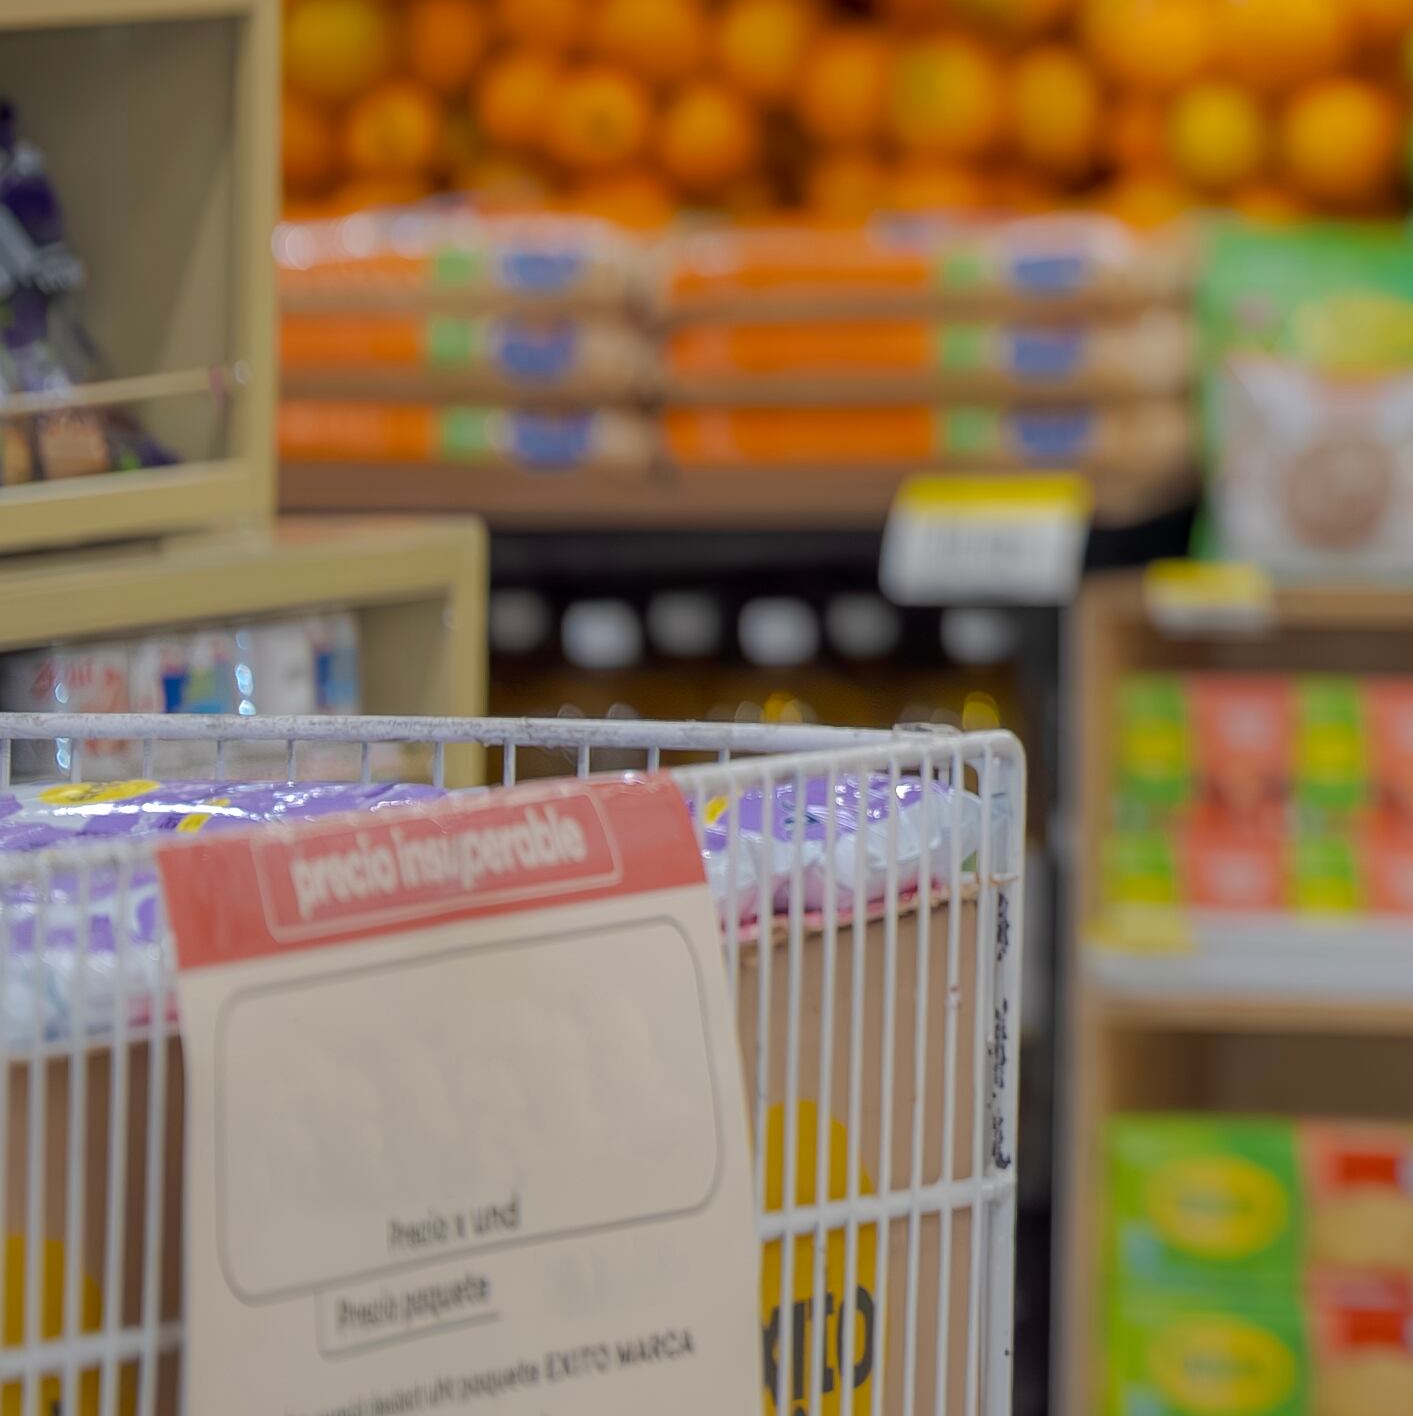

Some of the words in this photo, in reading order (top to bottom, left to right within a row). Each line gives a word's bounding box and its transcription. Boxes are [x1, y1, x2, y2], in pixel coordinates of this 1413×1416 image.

[291, 830, 397, 921] precio
[391, 804, 588, 890] insuperable
[387, 1206, 448, 1251] Precio
[473, 1191, 520, 1234] und
[336, 1289, 398, 1334] Precio
[404, 1271, 491, 1322] paquete
[461, 1360, 539, 1402] paquete
[615, 1328, 695, 1367] MARCA
